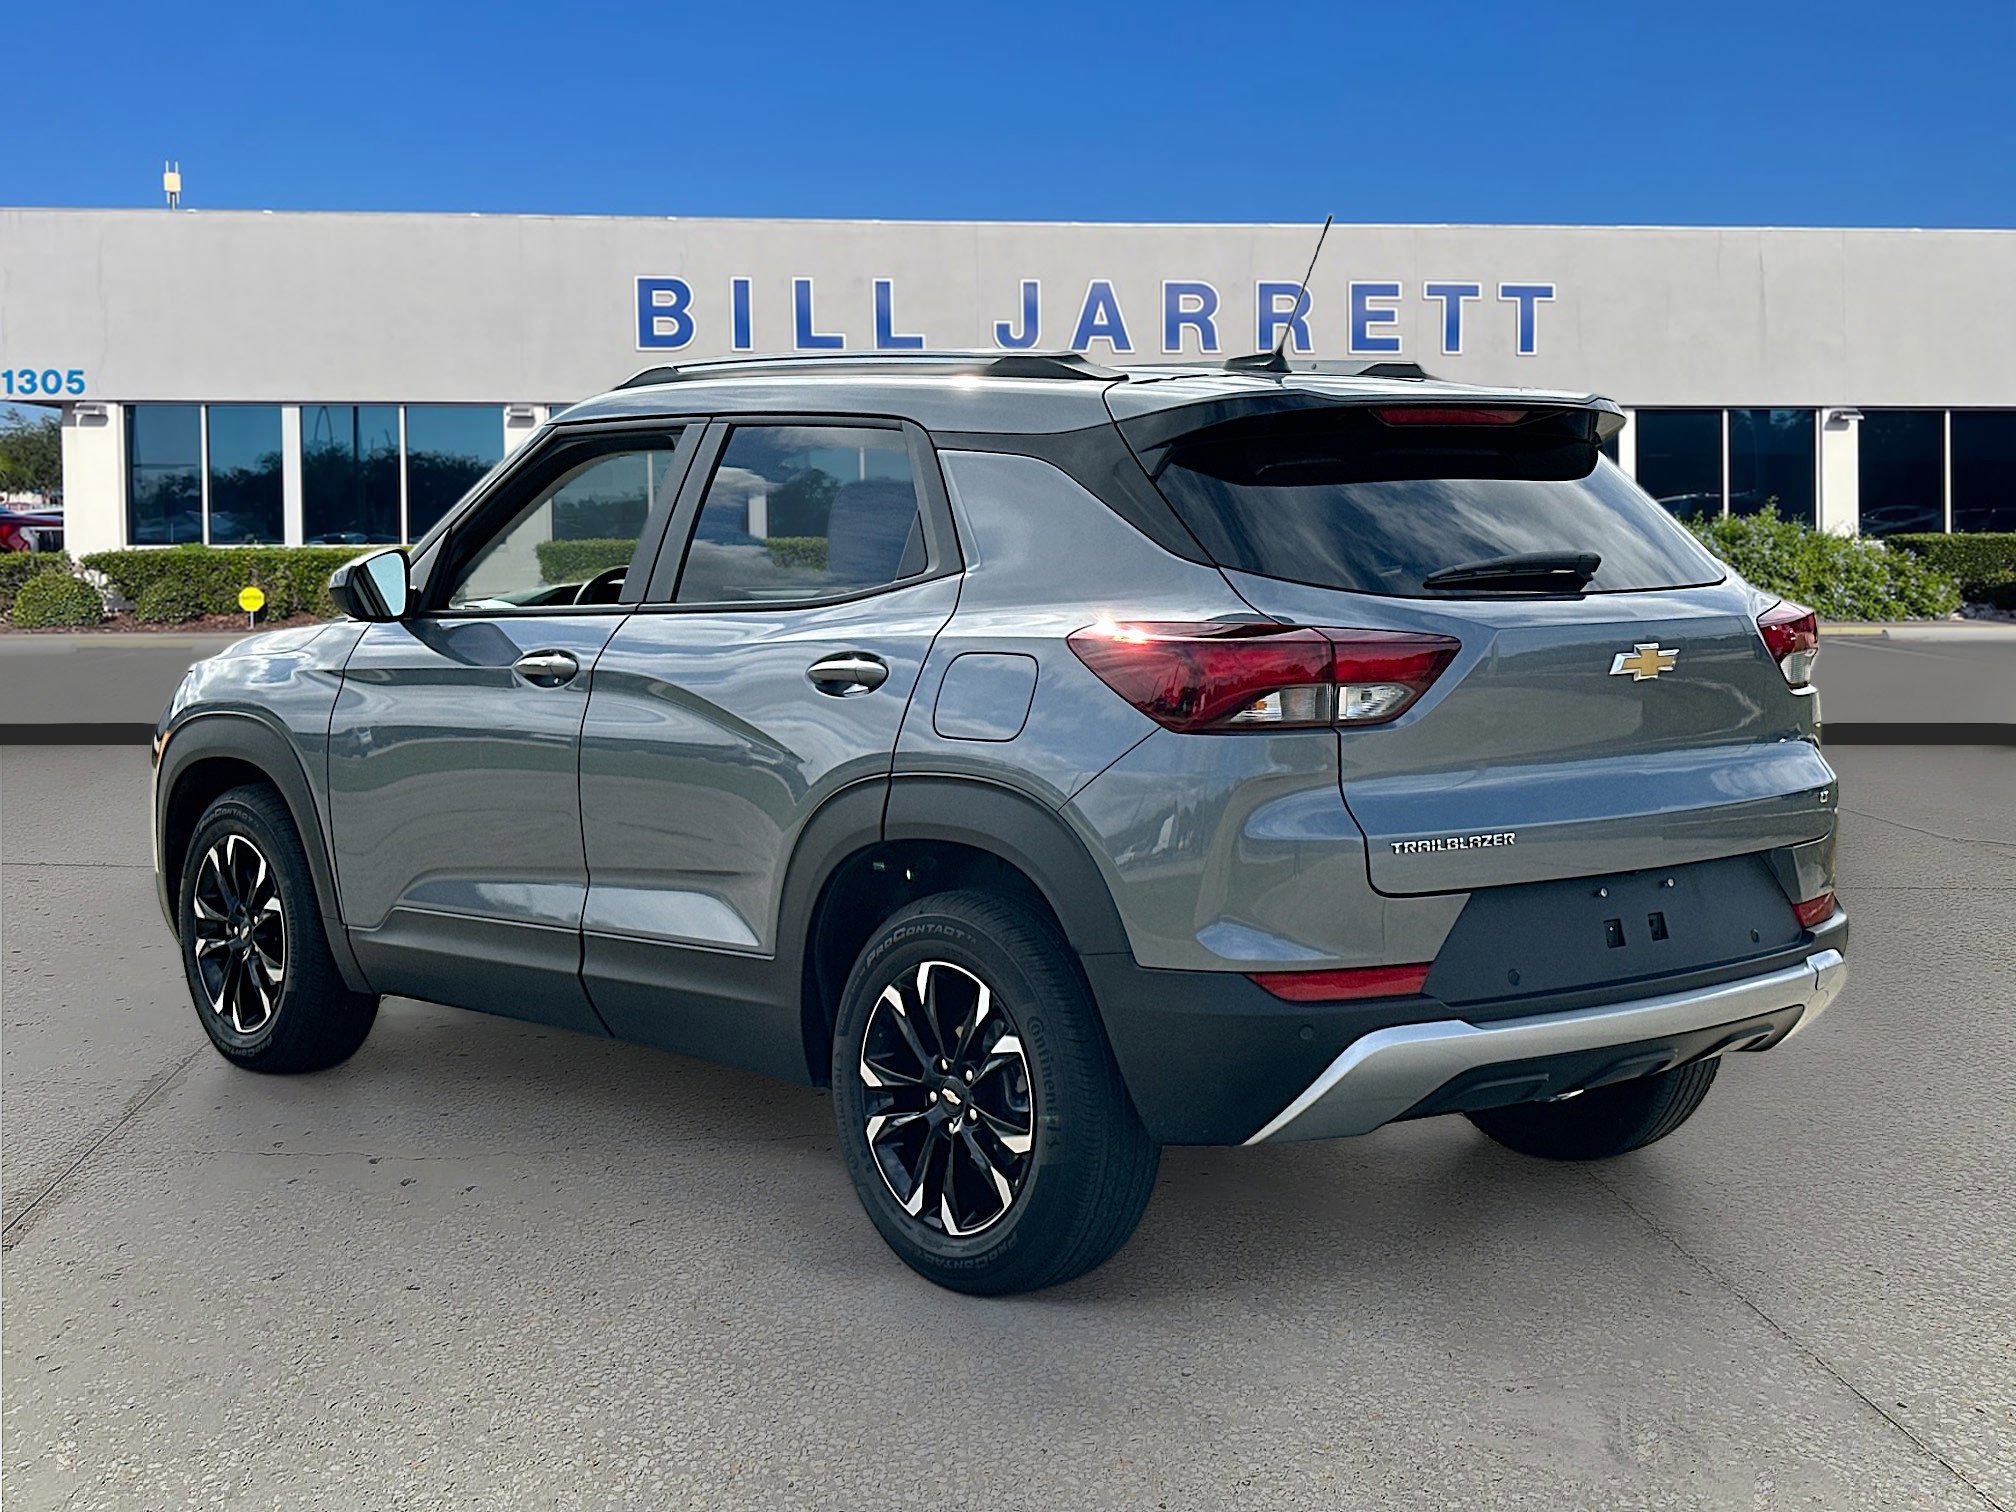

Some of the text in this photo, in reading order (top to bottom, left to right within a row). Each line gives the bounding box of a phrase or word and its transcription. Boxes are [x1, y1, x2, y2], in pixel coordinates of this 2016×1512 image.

[634, 275, 1556, 356] BILL JARRETT
[1, 368, 86, 395] 1305
[1390, 831, 1516, 854] TRAILBLAZER
